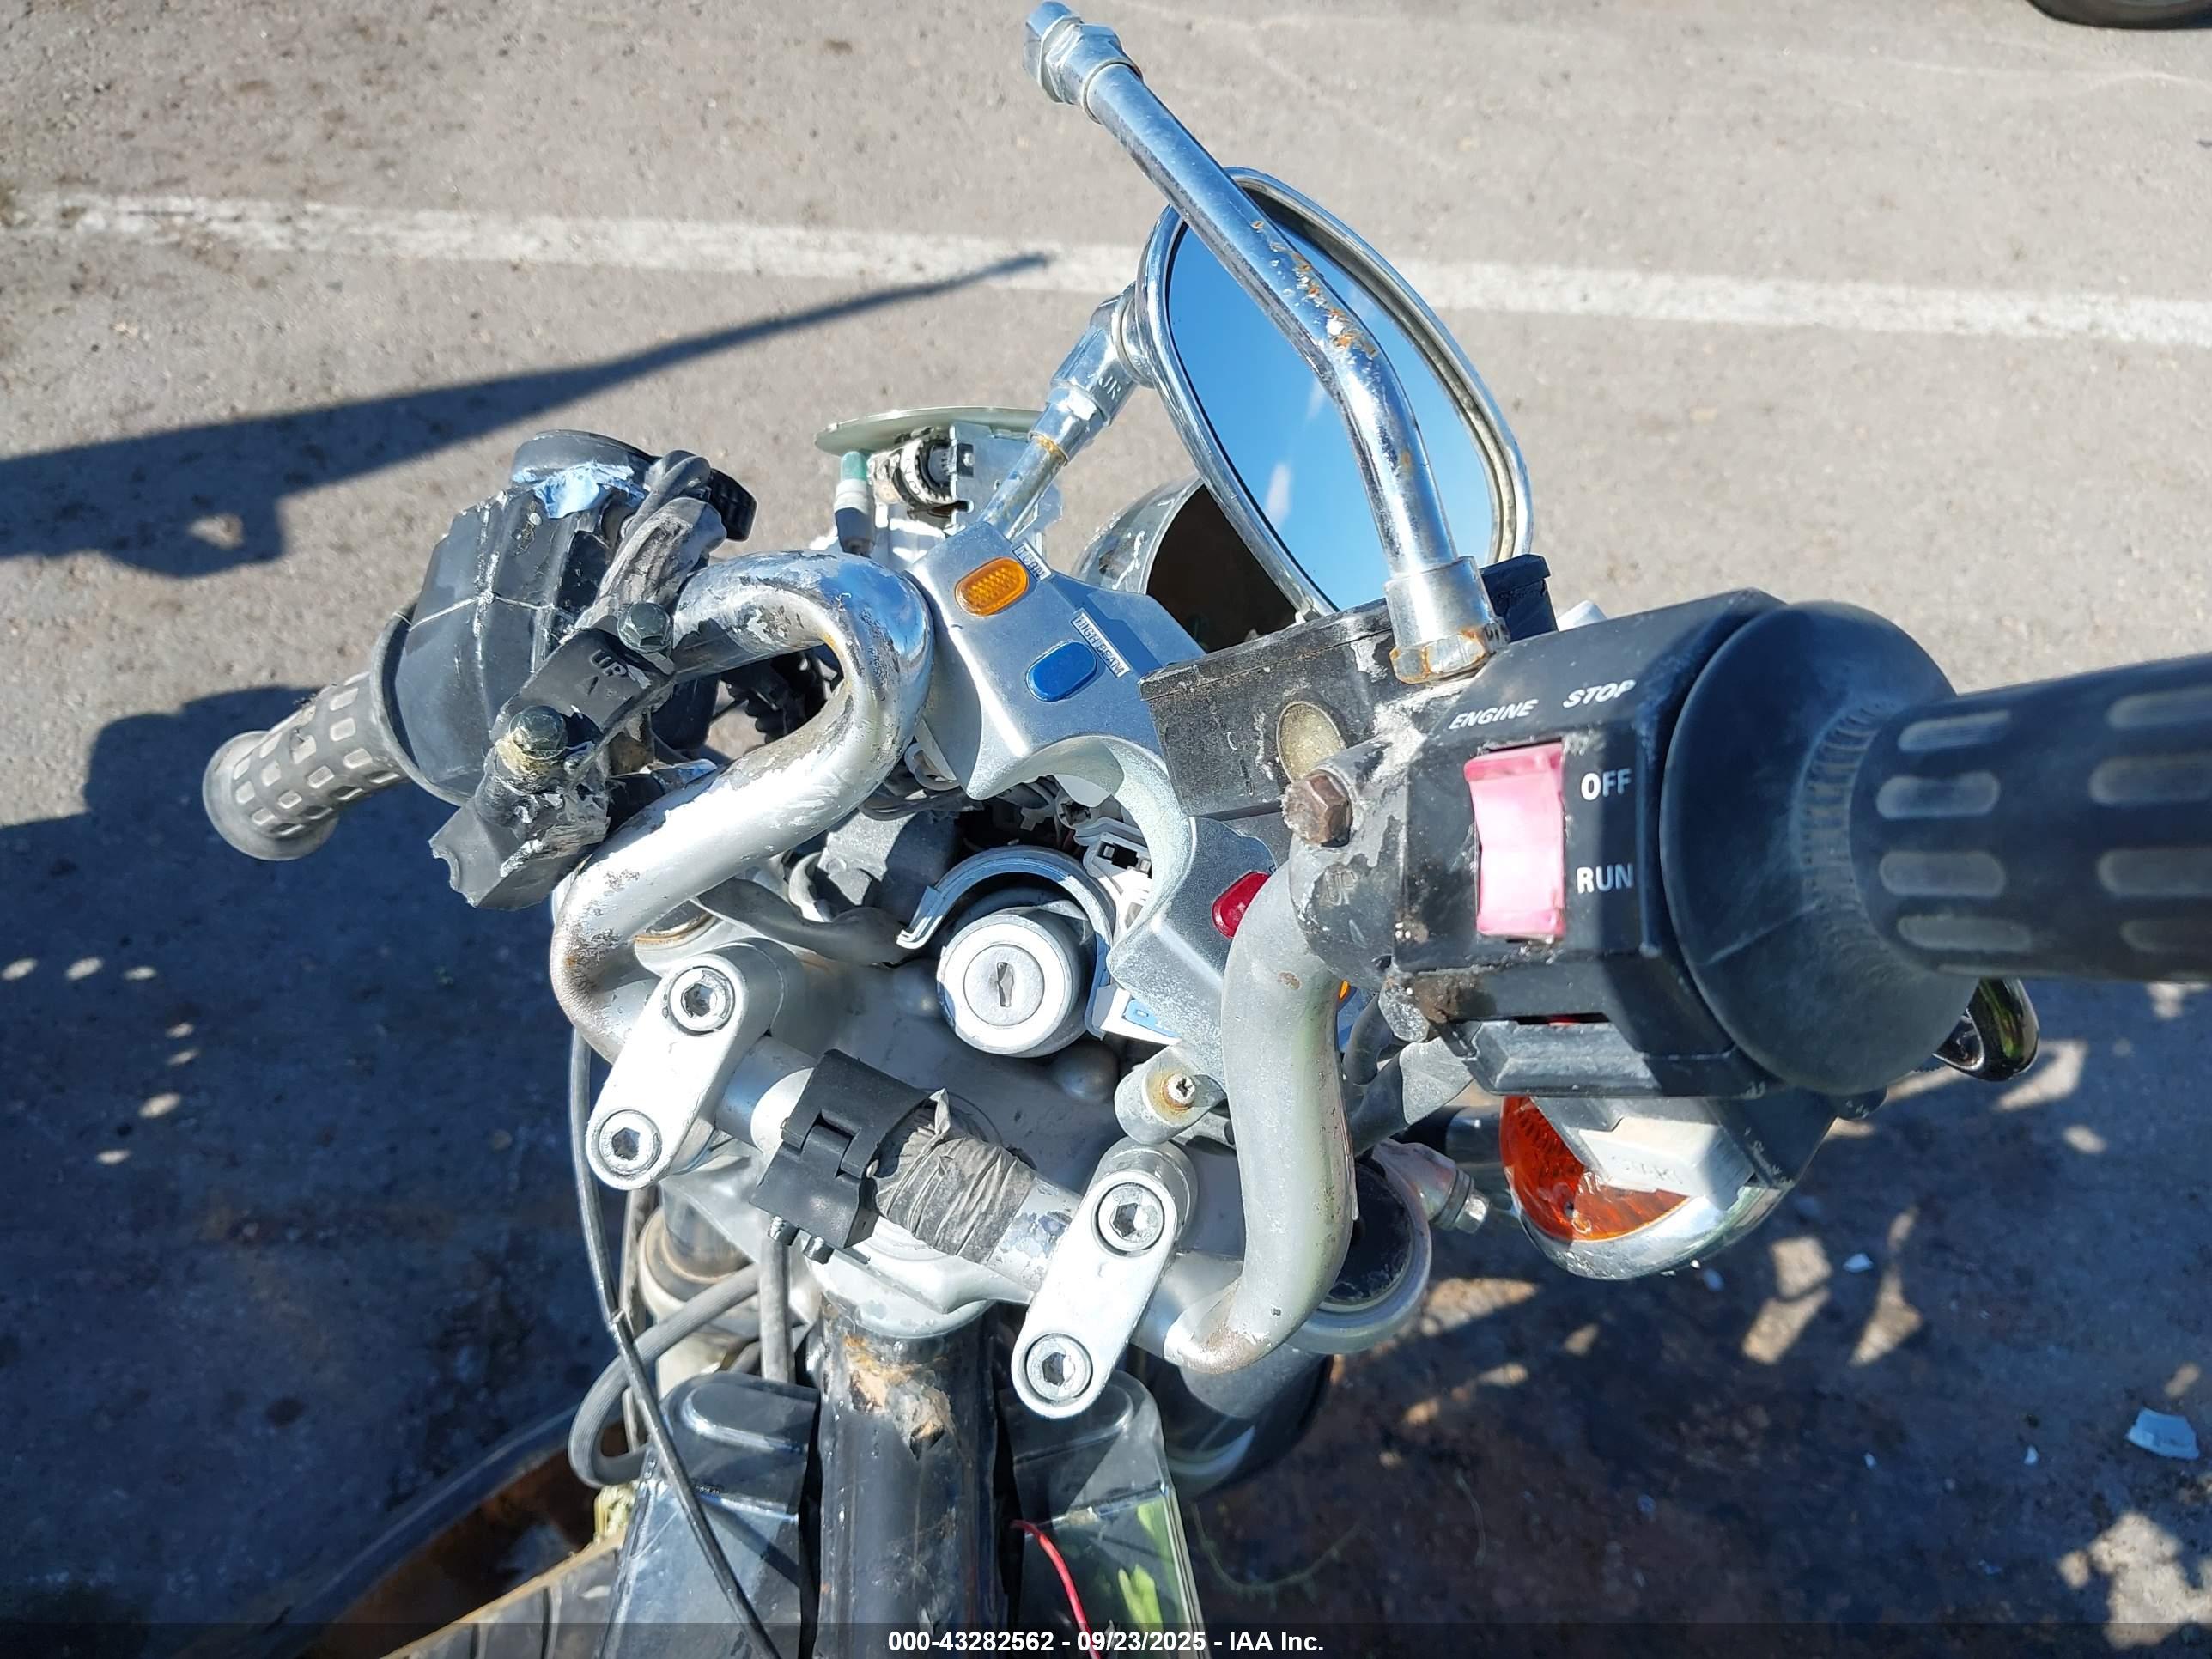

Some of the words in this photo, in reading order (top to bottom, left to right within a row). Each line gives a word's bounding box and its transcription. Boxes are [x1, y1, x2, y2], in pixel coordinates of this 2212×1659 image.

[1018, 547, 1047, 579] TURN
[1074, 616, 1098, 648] HIGH
[1096, 641, 1125, 674] BEAM
[1448, 699, 1540, 730] ENGINE
[1562, 679, 1637, 708] STOP
[1580, 768, 1633, 801] OFF
[1576, 863, 1634, 895] RUN
